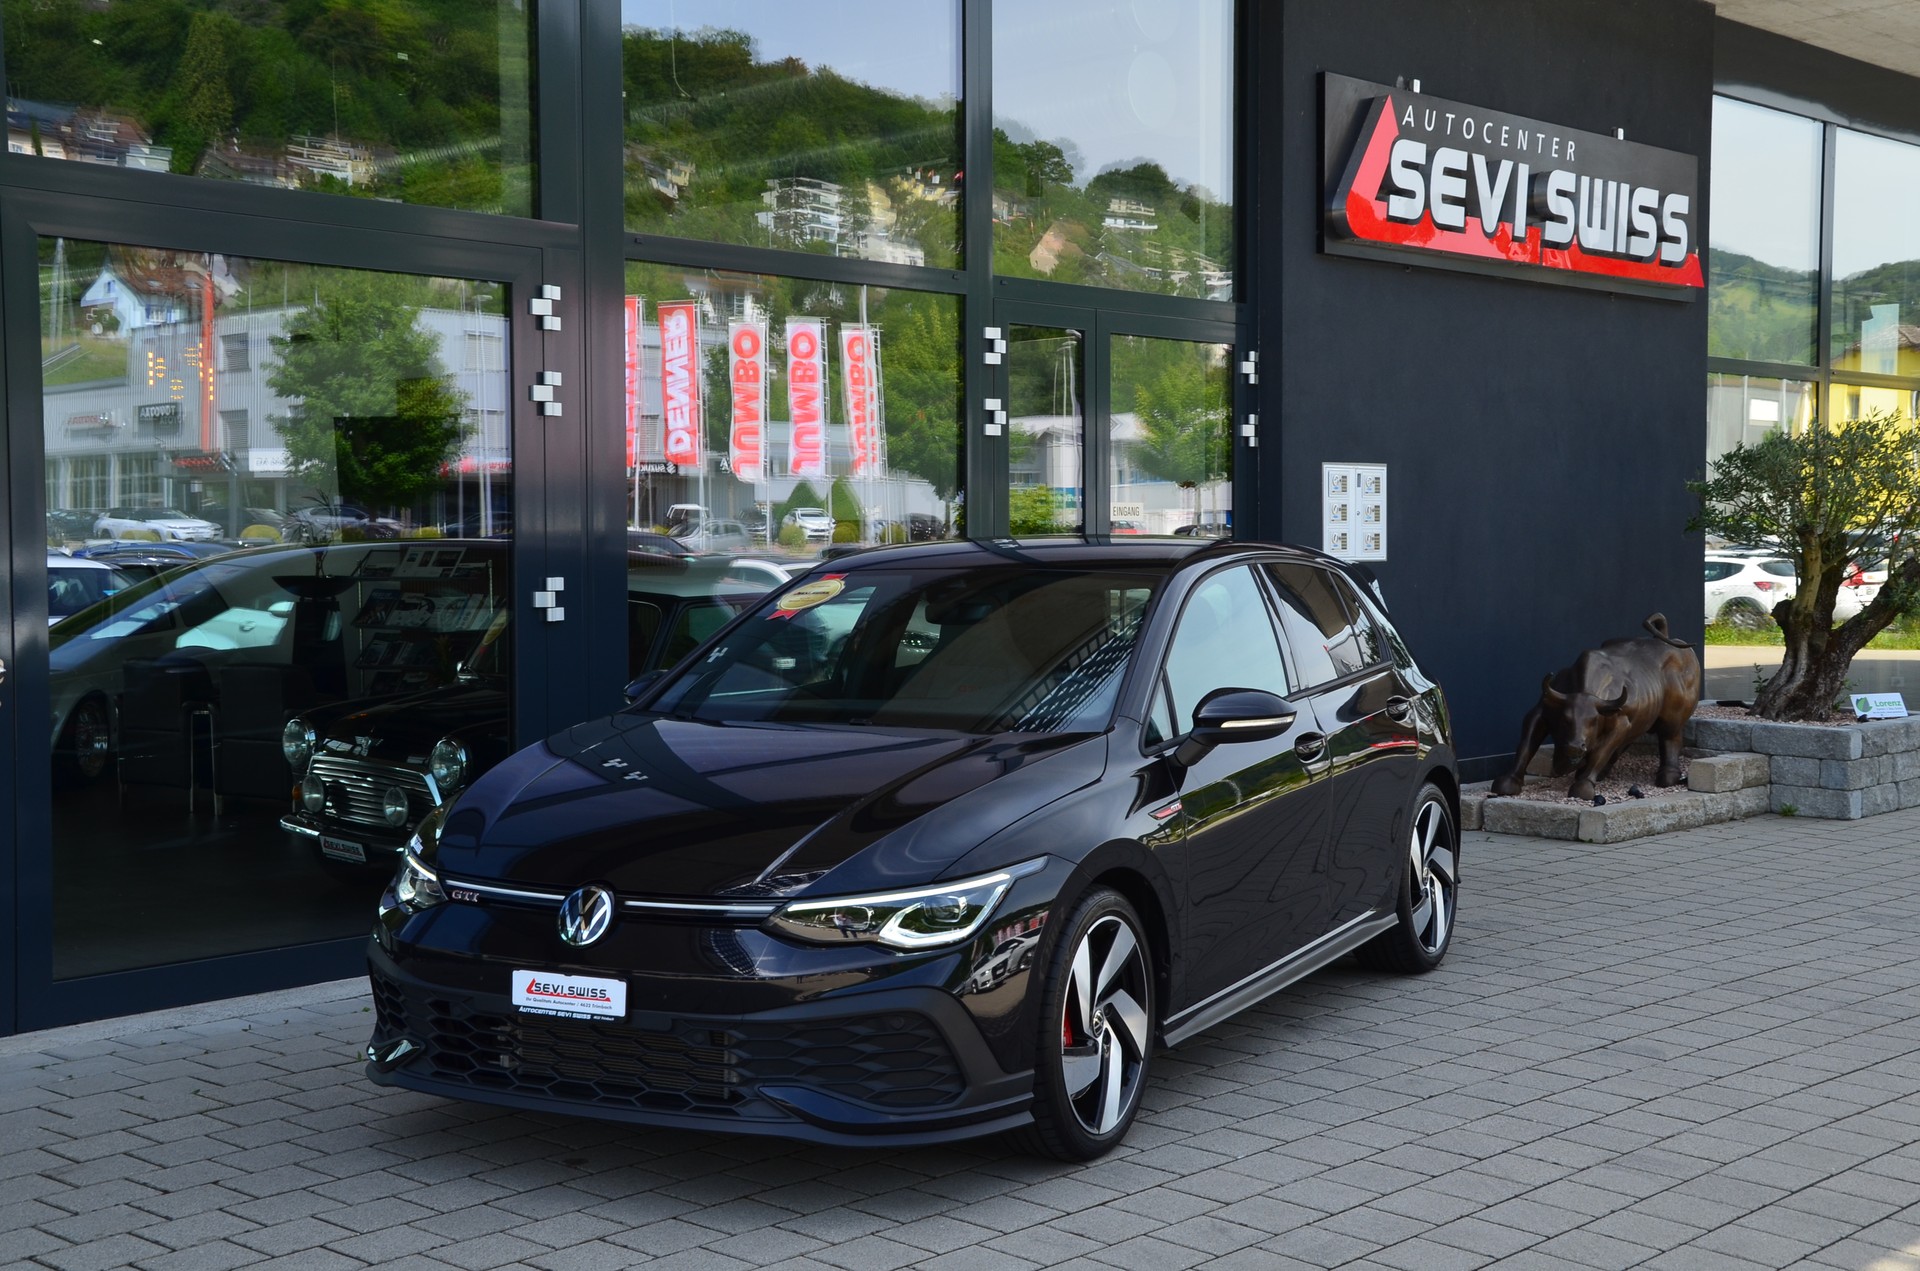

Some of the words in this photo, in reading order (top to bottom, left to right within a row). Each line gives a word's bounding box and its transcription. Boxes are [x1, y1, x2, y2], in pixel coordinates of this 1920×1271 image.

[1402, 105, 1576, 162] AUTOCENTER
[1387, 138, 1529, 239] SEVI
[1544, 169, 1690, 262] SWISS
[1112, 506, 1140, 517] EINGANG
[452, 889, 480, 902] GTI
[534, 982, 563, 994] SEVI
[567, 986, 607, 998] SWISS
